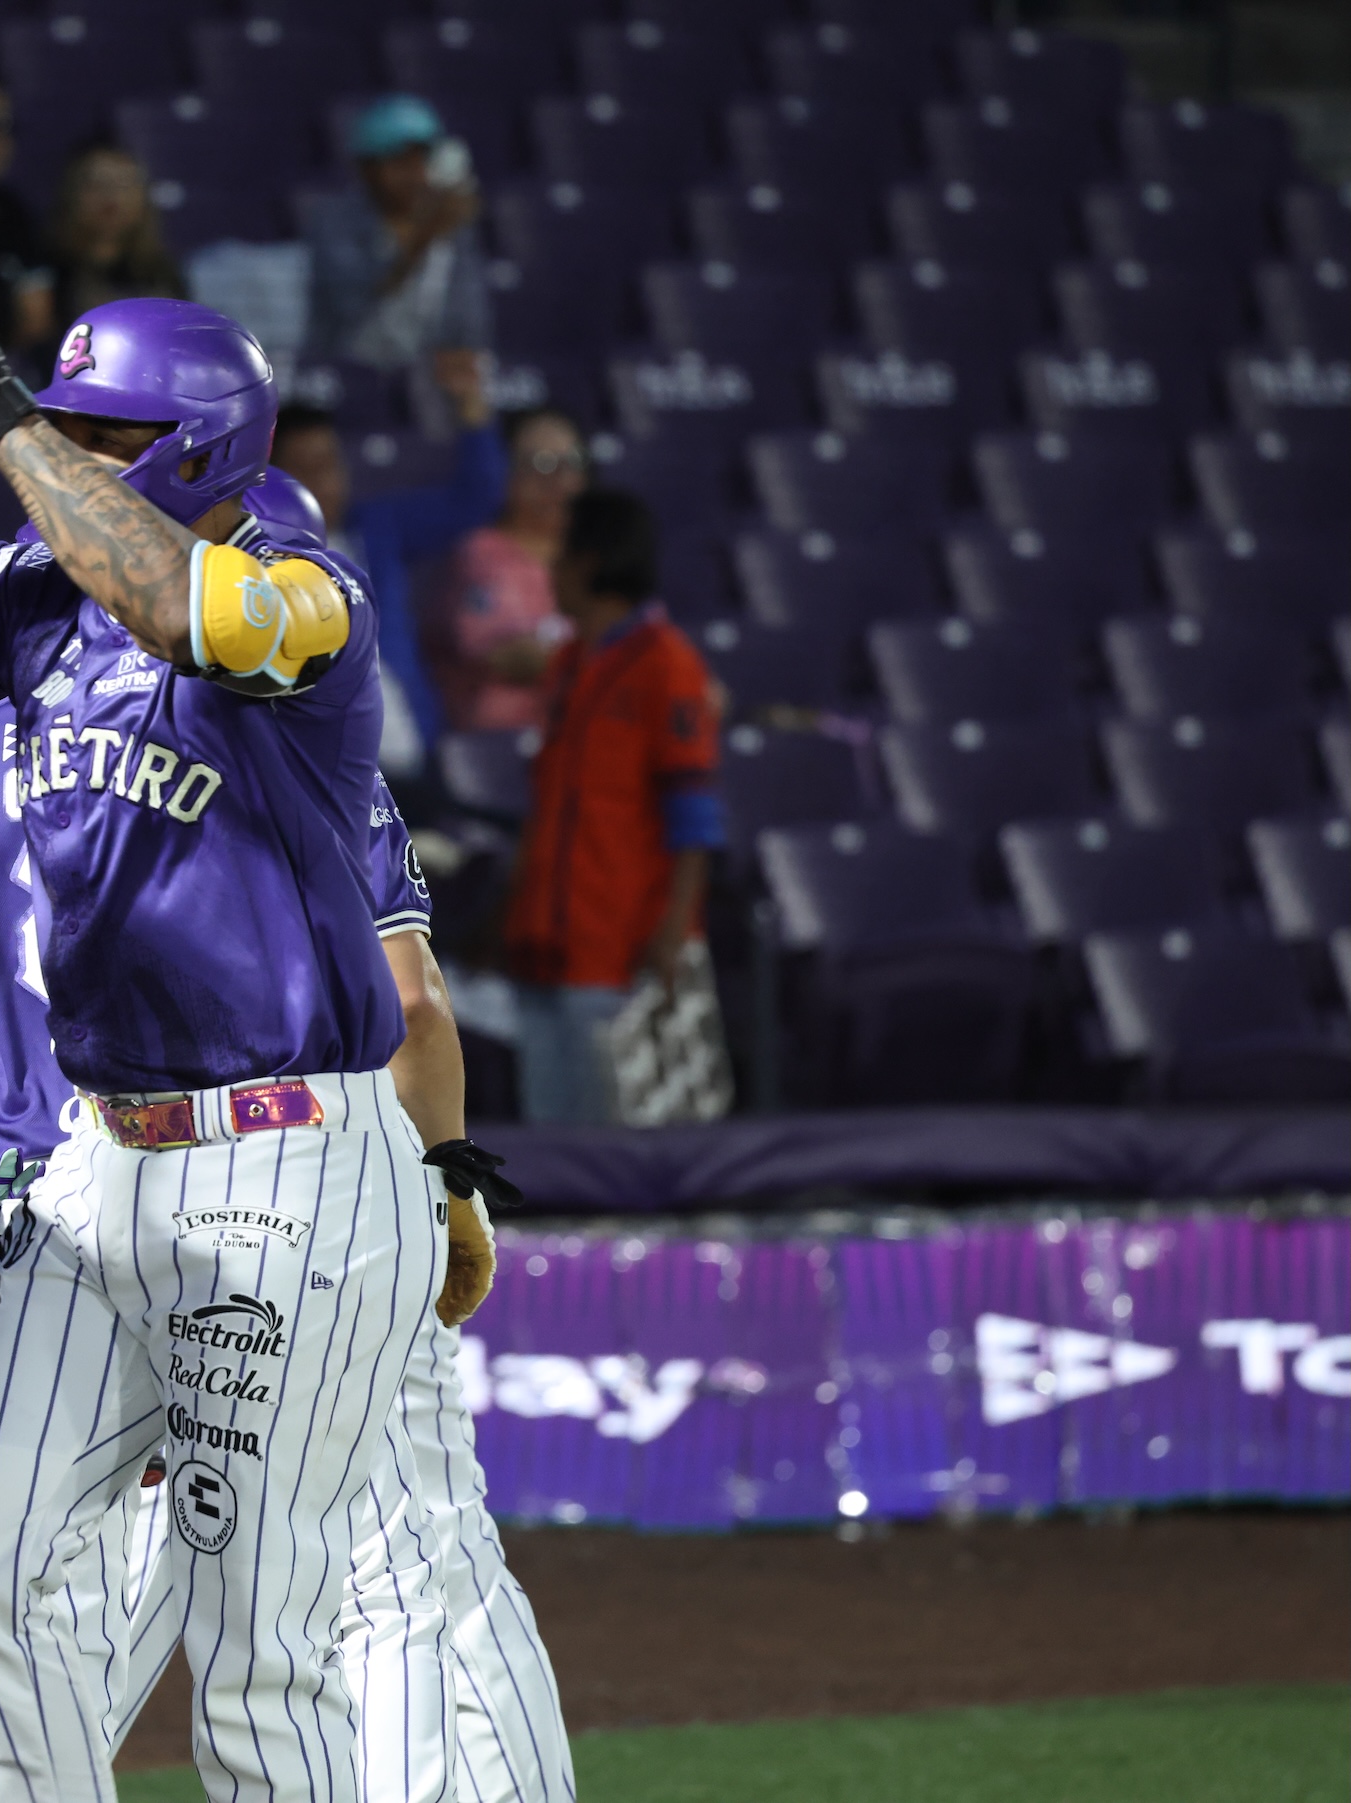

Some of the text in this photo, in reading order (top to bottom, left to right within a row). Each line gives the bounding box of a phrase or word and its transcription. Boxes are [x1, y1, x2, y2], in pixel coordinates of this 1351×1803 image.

[92, 670, 159, 695] XENTRA
[184, 1210, 296, 1237] L'OSTERIA
[211, 1238, 261, 1250] IL DUOMO
[168, 1311, 286, 1358] Electrolit
[166, 1401, 260, 1457] Corona
[176, 1496, 234, 1549] CONSTRULANDIA
